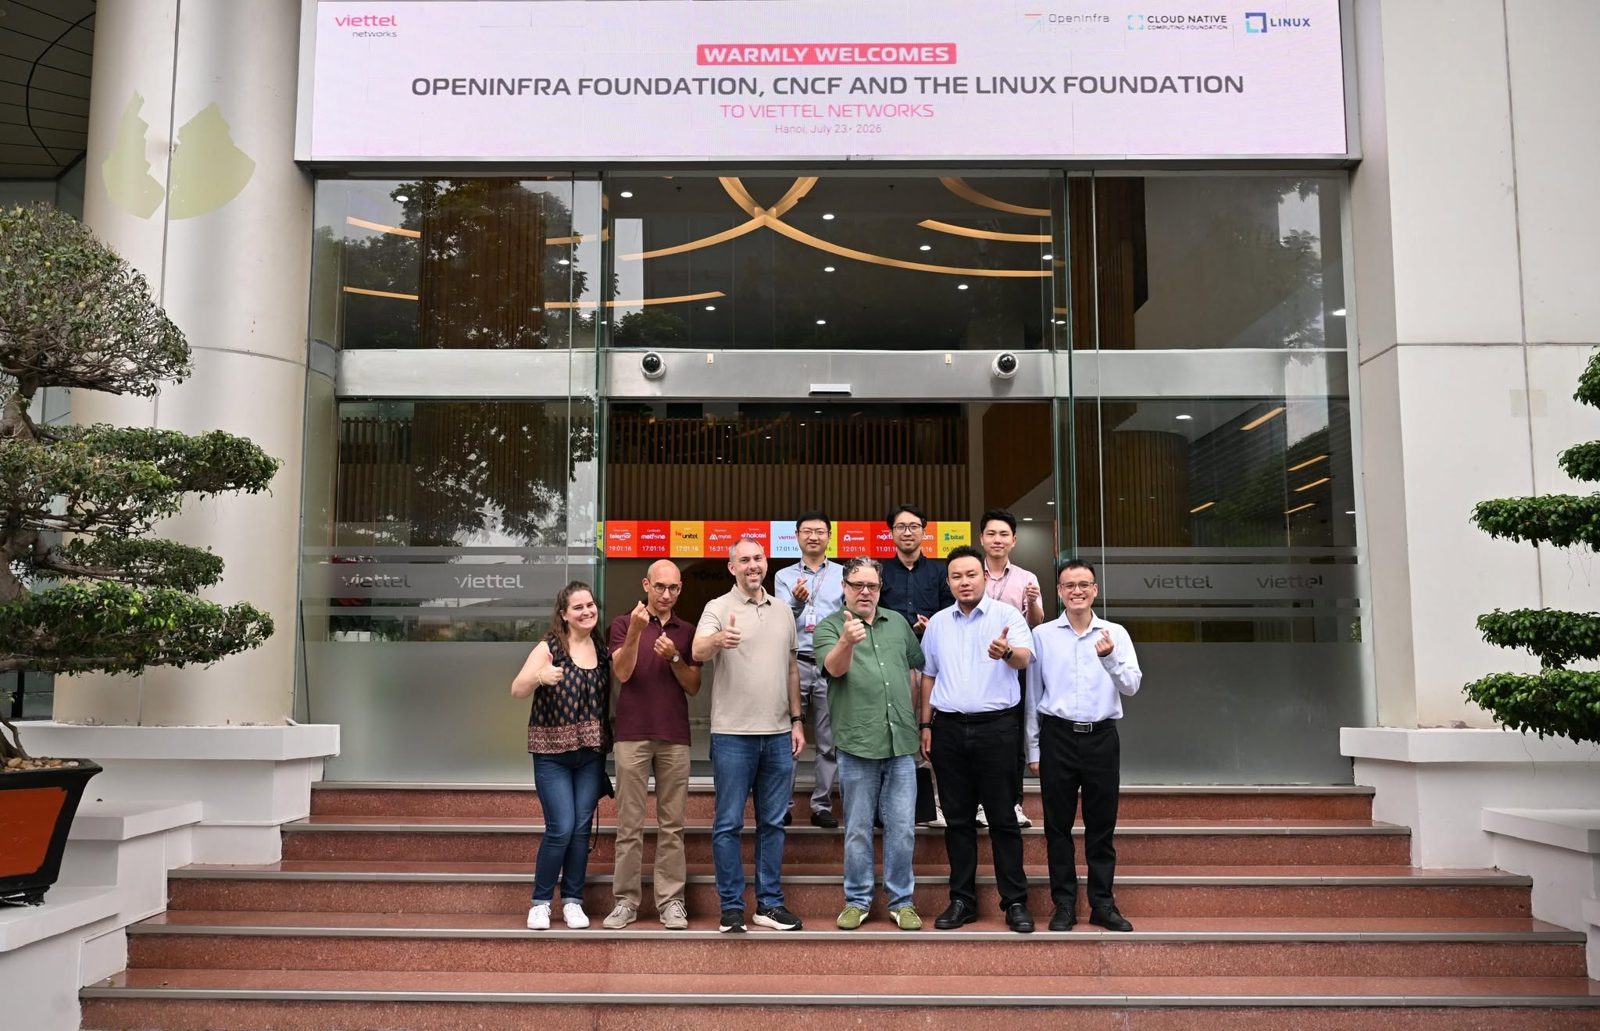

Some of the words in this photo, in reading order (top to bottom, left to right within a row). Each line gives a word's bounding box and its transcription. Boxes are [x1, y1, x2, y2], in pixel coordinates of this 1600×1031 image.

[334, 14, 398, 27] viettel
[1048, 13, 1111, 25] OpenInfra
[1147, 15, 1185, 24] CLOUD
[1188, 15, 1228, 24] NATIVE
[1269, 17, 1312, 28] LINUX
[703, 47, 809, 63] WARMLY
[815, 46, 950, 62] WELCOMES
[411, 77, 572, 96] OPENINFRA
[577, 77, 765, 97] FOUNDATION,
[772, 77, 843, 95] CNCF
[848, 76, 908, 95] AND
[914, 76, 969, 94] THE
[975, 76, 1057, 94] LINUX
[1062, 75, 1244, 94] FOUNDATION
[720, 104, 745, 119] TO
[749, 104, 825, 118] VIETTEL
[827, 103, 935, 118] NETWORKS
[809, 124, 832, 136] July
[855, 124, 882, 134] 2026
[341, 573, 412, 589] viettel
[453, 573, 525, 589] viettel
[1142, 574, 1214, 590] viettel
